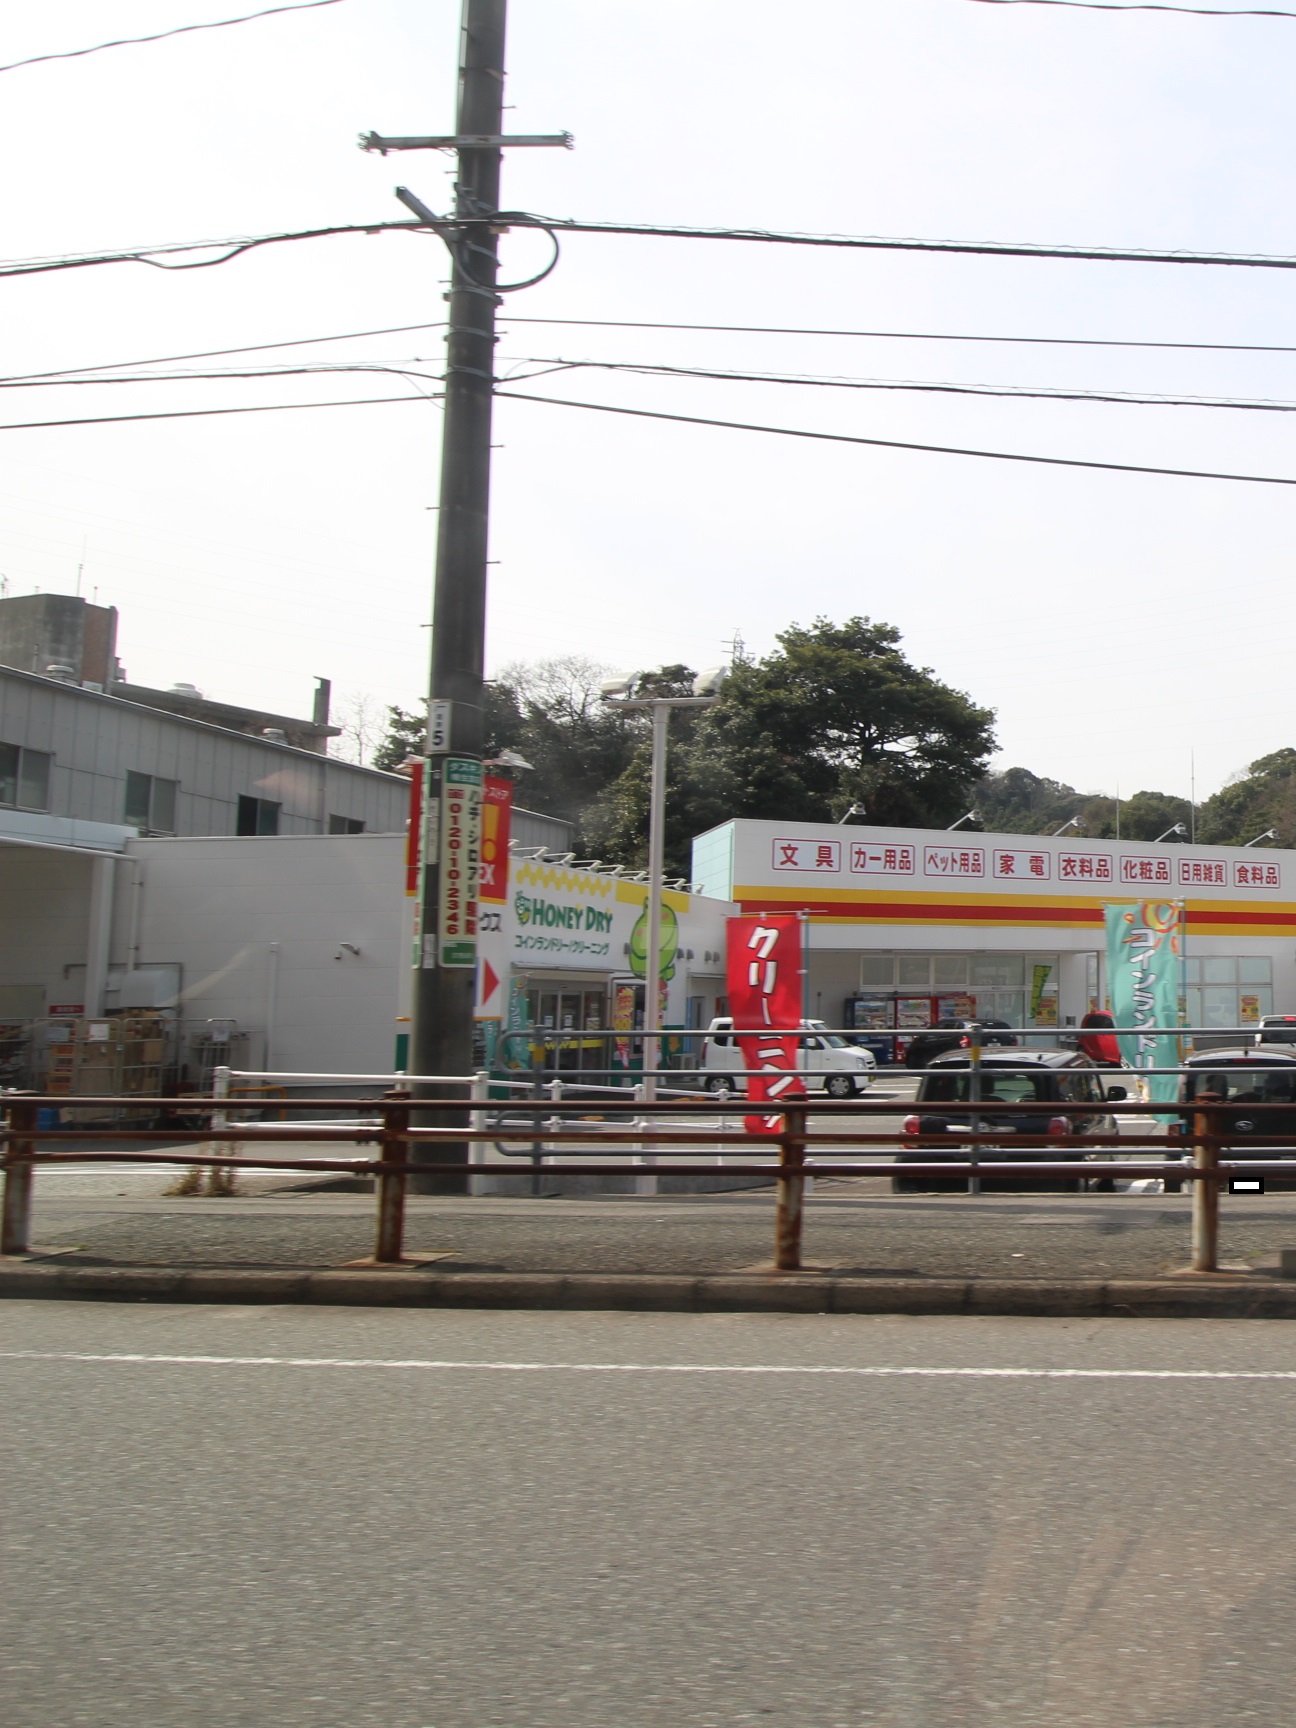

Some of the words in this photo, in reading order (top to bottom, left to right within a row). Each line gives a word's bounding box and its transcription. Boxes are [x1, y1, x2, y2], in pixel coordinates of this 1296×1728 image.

[854, 848, 911, 871] カー用品
[928, 852, 982, 873] ペット用品
[1062, 857, 1110, 878] 衣料品
[1123, 860, 1168, 881] 化粧品
[1182, 863, 1225, 882] 日用雑貨
[1237, 866, 1278, 885] 食料品
[532, 898, 583, 930] HONEY
[585, 905, 613, 934] DRY
